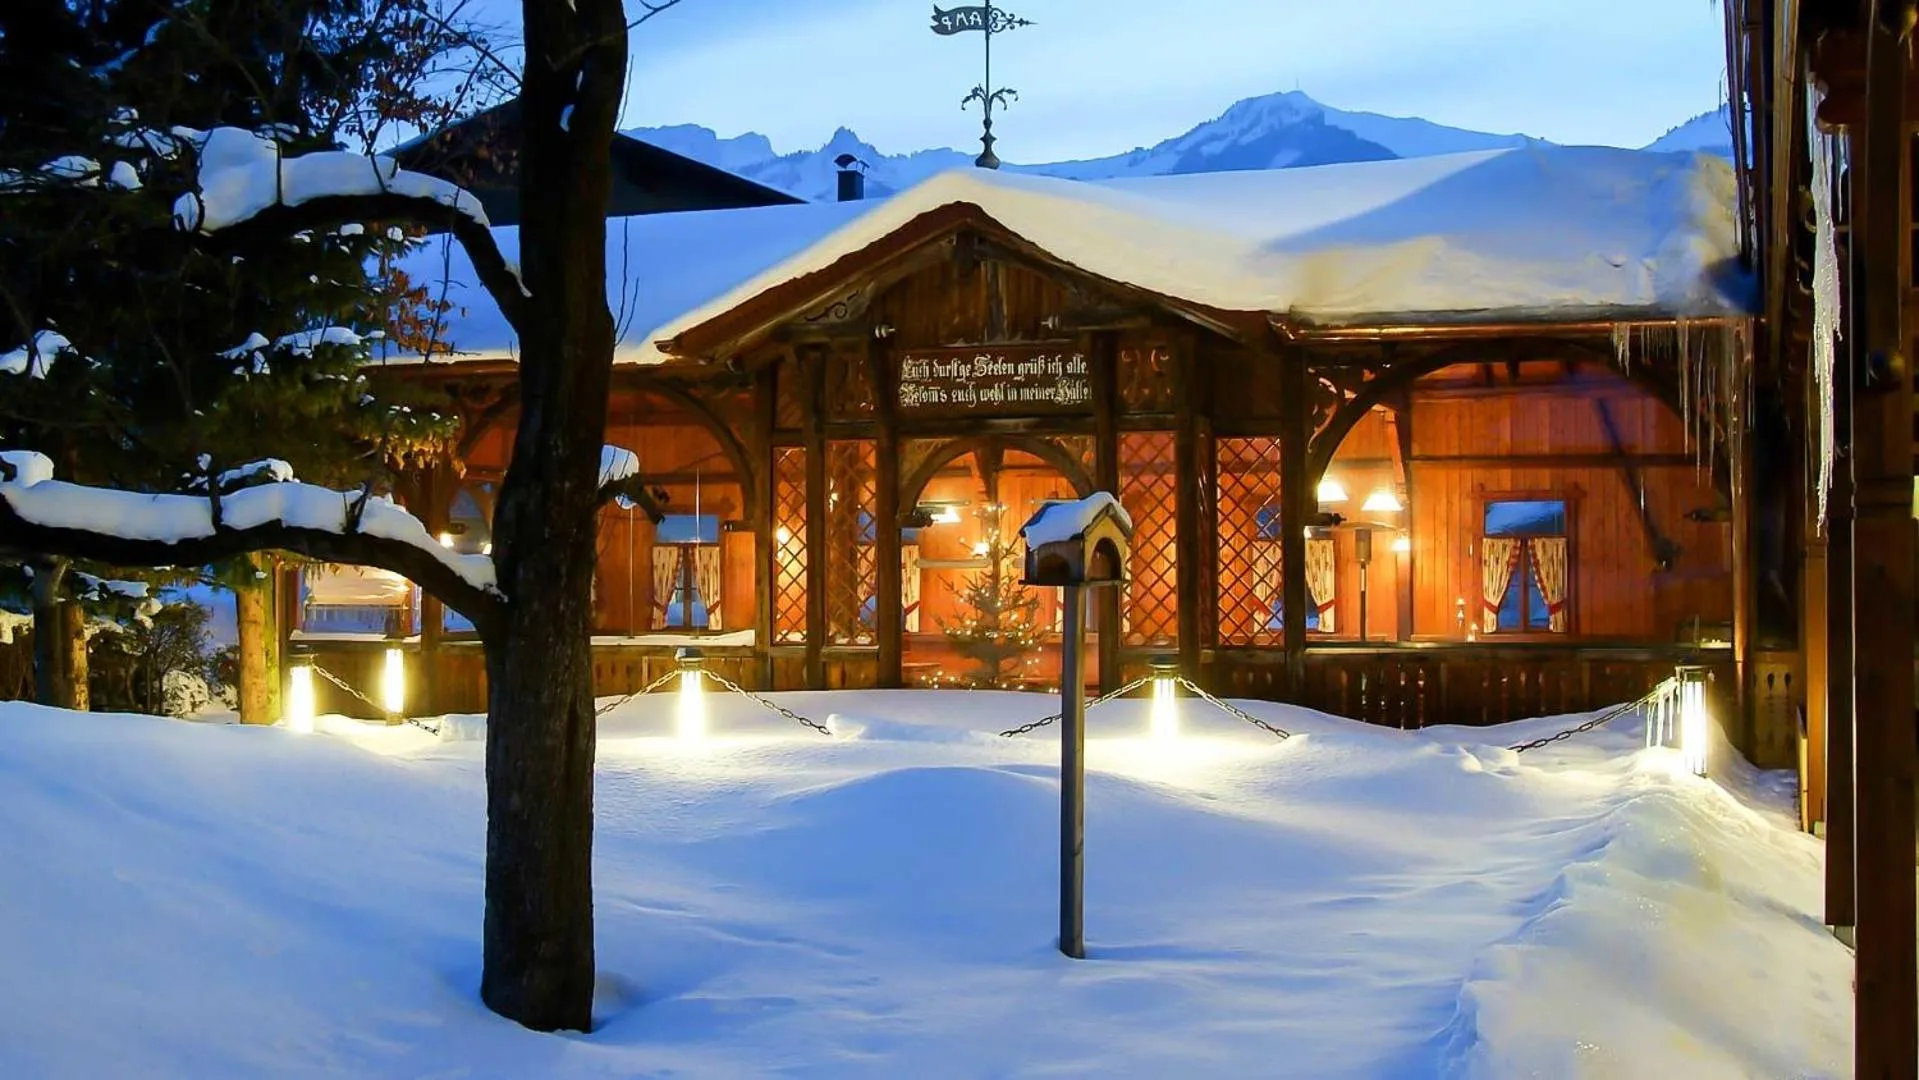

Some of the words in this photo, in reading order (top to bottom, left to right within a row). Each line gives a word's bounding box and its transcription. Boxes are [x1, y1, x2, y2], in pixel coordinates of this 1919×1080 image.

[901, 355, 930, 382] Euch
[972, 354, 1014, 377] Seelen
[1013, 355, 1046, 381] grüß
[1048, 354, 1063, 379] ich
[951, 381, 977, 408] euch
[1007, 384, 1017, 401] in
[1020, 383, 1056, 401] meiner
